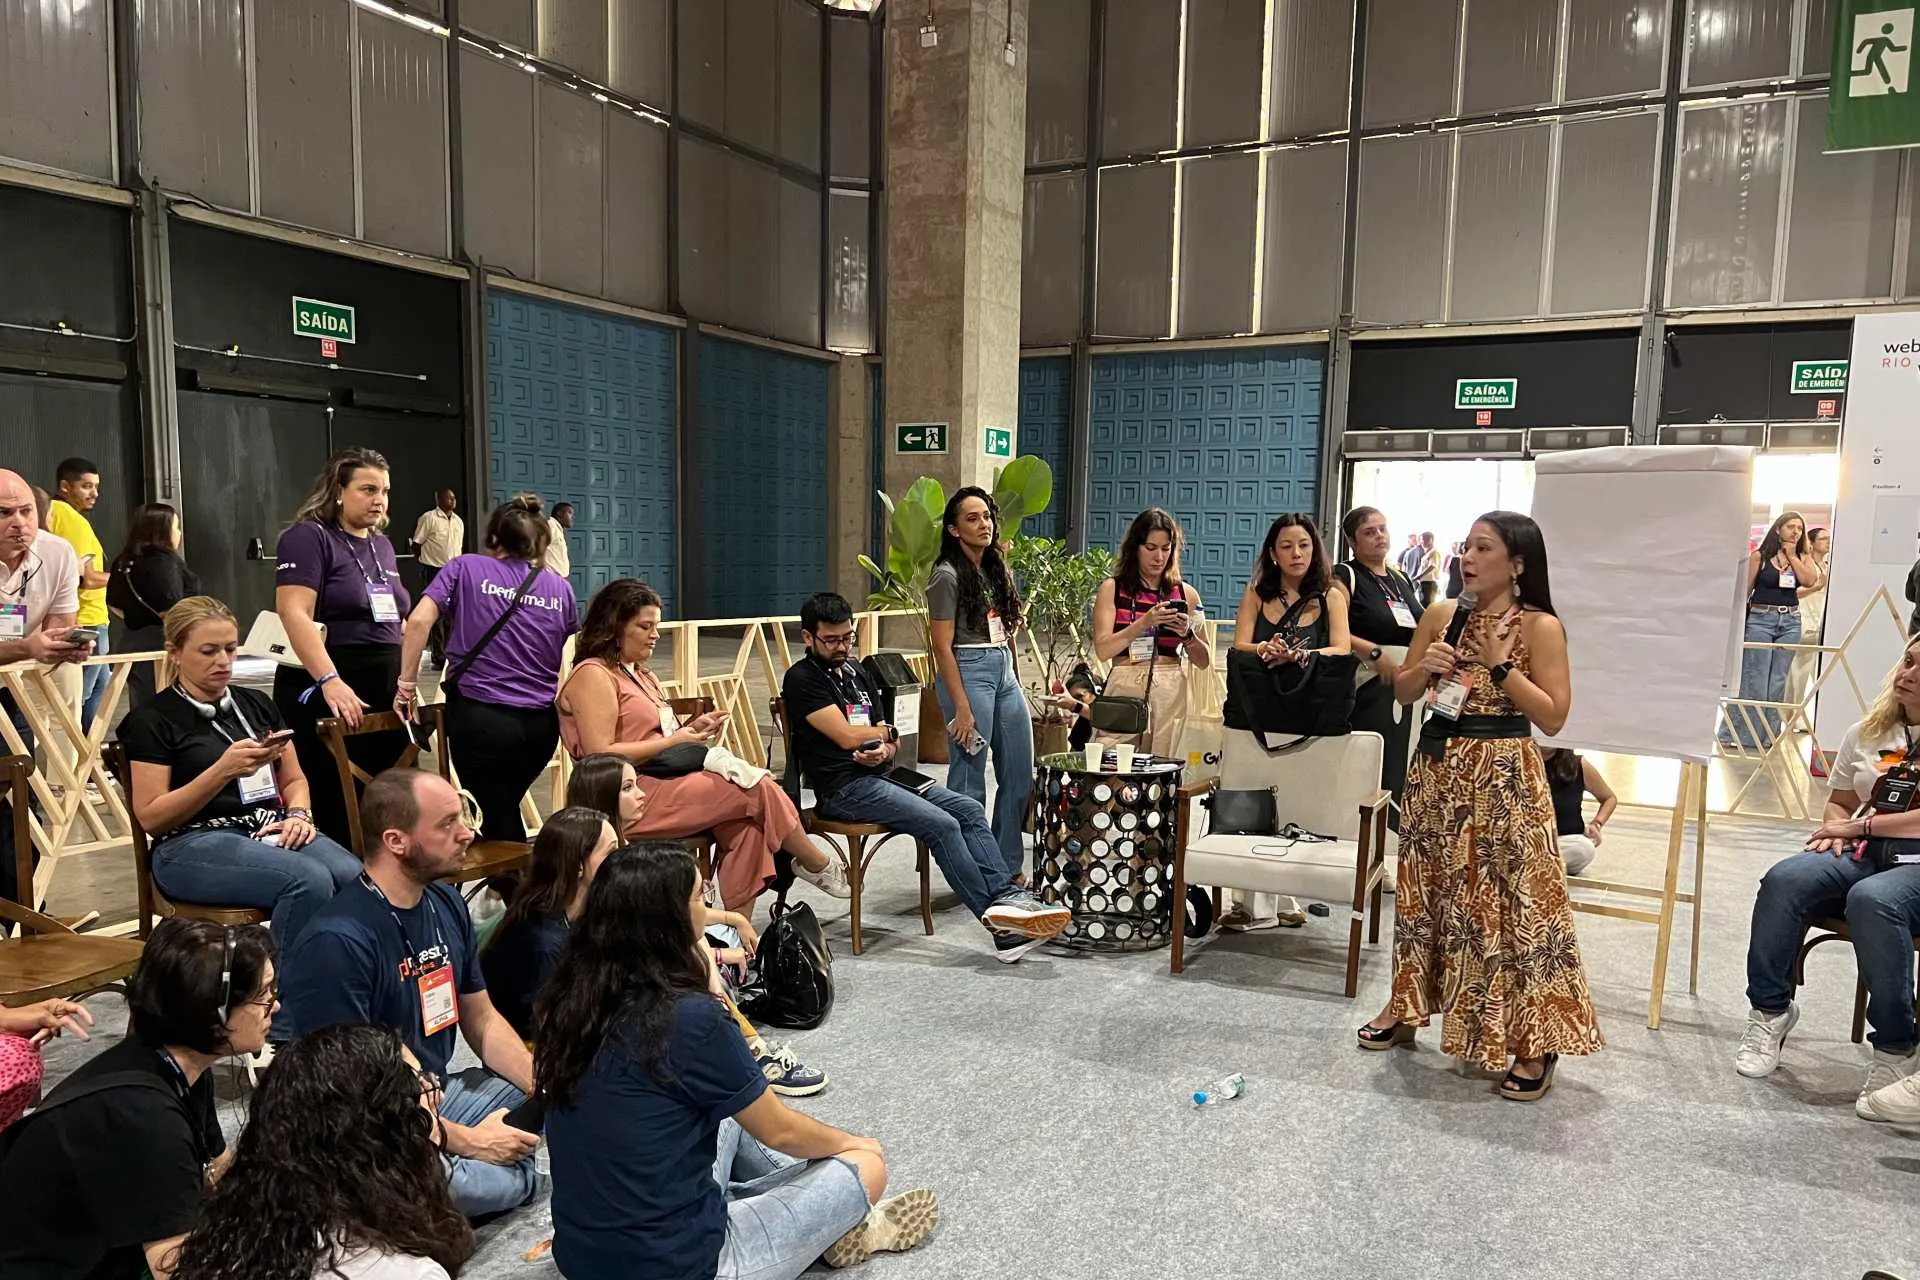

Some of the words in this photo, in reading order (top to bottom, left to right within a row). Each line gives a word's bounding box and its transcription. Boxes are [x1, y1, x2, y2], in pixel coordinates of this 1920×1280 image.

[300, 311, 349, 333] SAÍDA
[1884, 339, 1920, 353] web
[1882, 357, 1911, 368] RIO
[1798, 380, 1808, 388] DE
[1809, 378, 1845, 388] EMERGÊN
[1464, 384, 1507, 396] SAÍDA
[1461, 396, 1470, 404] DE
[1471, 395, 1510, 404] EMERGÊNCIA
